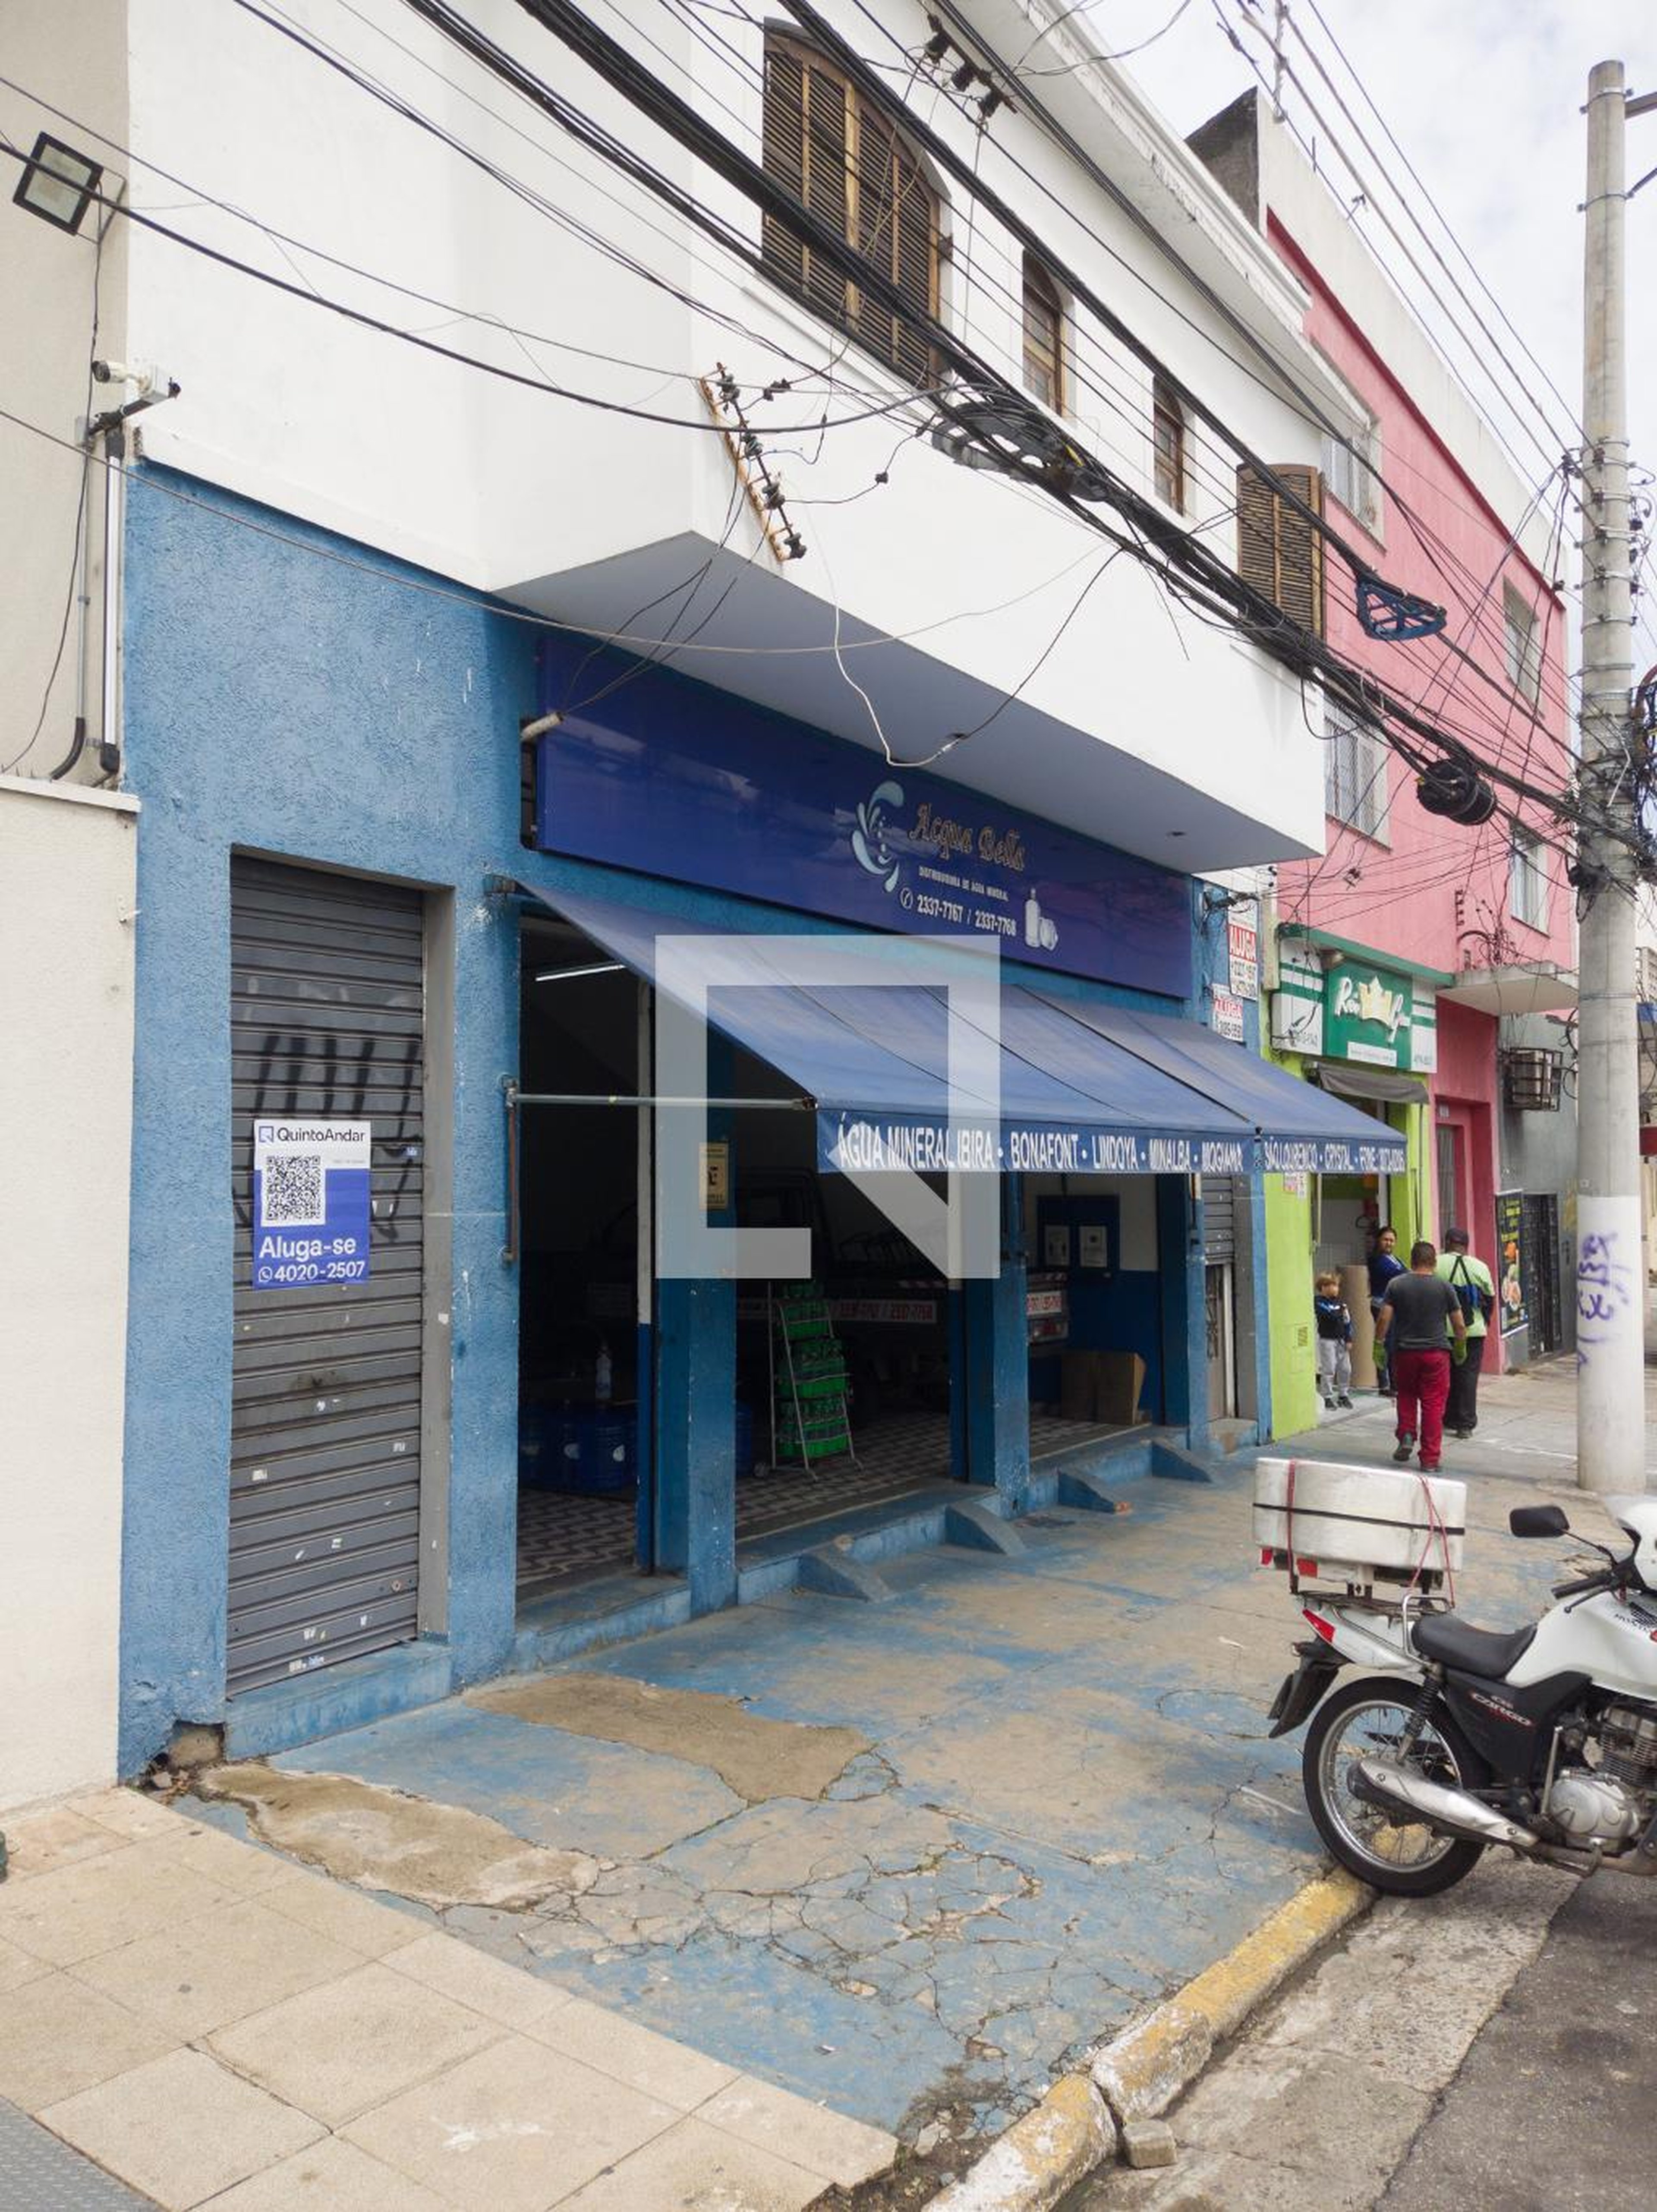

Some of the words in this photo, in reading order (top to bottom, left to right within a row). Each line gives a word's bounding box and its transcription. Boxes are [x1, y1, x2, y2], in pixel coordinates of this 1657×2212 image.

[277, 1126, 365, 1143] QuintoAndar
[887, 1126, 953, 1169] MINERAL
[1010, 1131, 1080, 1170] BONAFONT
[1092, 1135, 1139, 1171] LINDOYA
[259, 1236, 356, 1262] Aluga-se
[274, 1260, 365, 1282] 4020-2507
